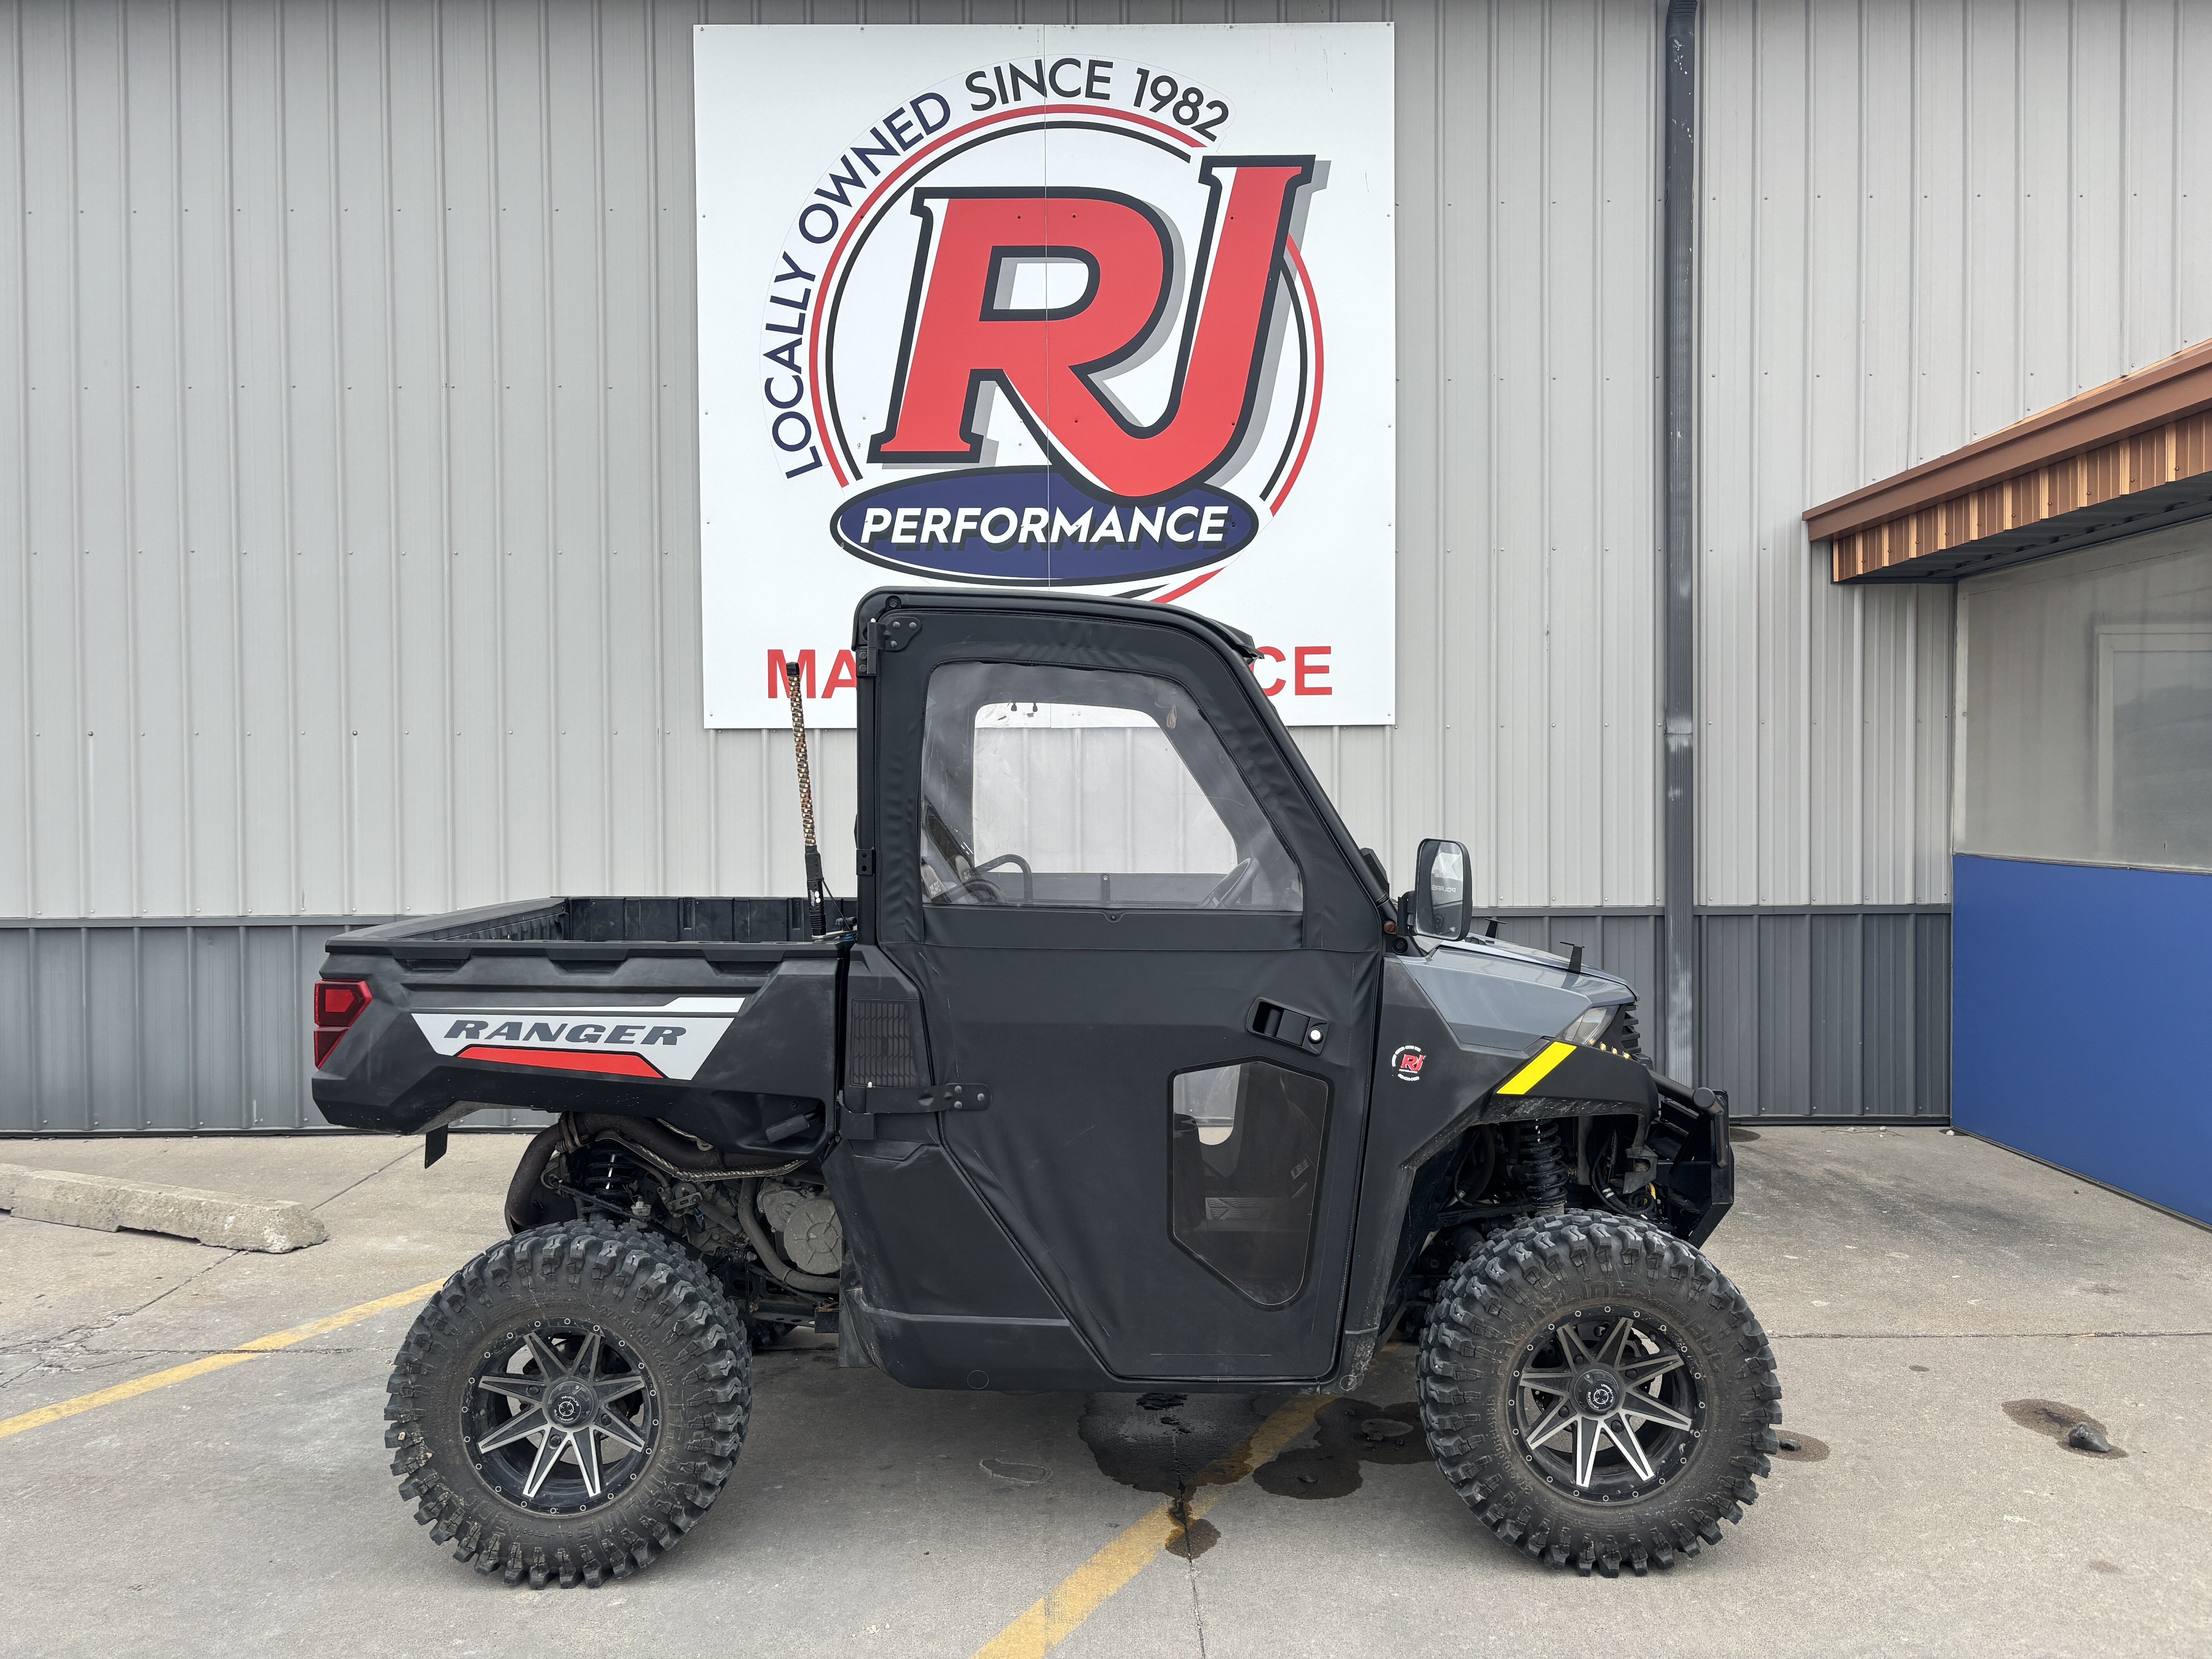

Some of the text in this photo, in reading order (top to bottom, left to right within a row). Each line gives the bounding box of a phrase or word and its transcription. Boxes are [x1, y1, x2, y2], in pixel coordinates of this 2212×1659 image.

[763, 58, 1229, 479] LOCALLY OWNED SINCE 1982
[867, 155, 1317, 504] RJ
[860, 506, 1229, 543] PERFORMANCE
[444, 1019, 687, 1045] RANGER
